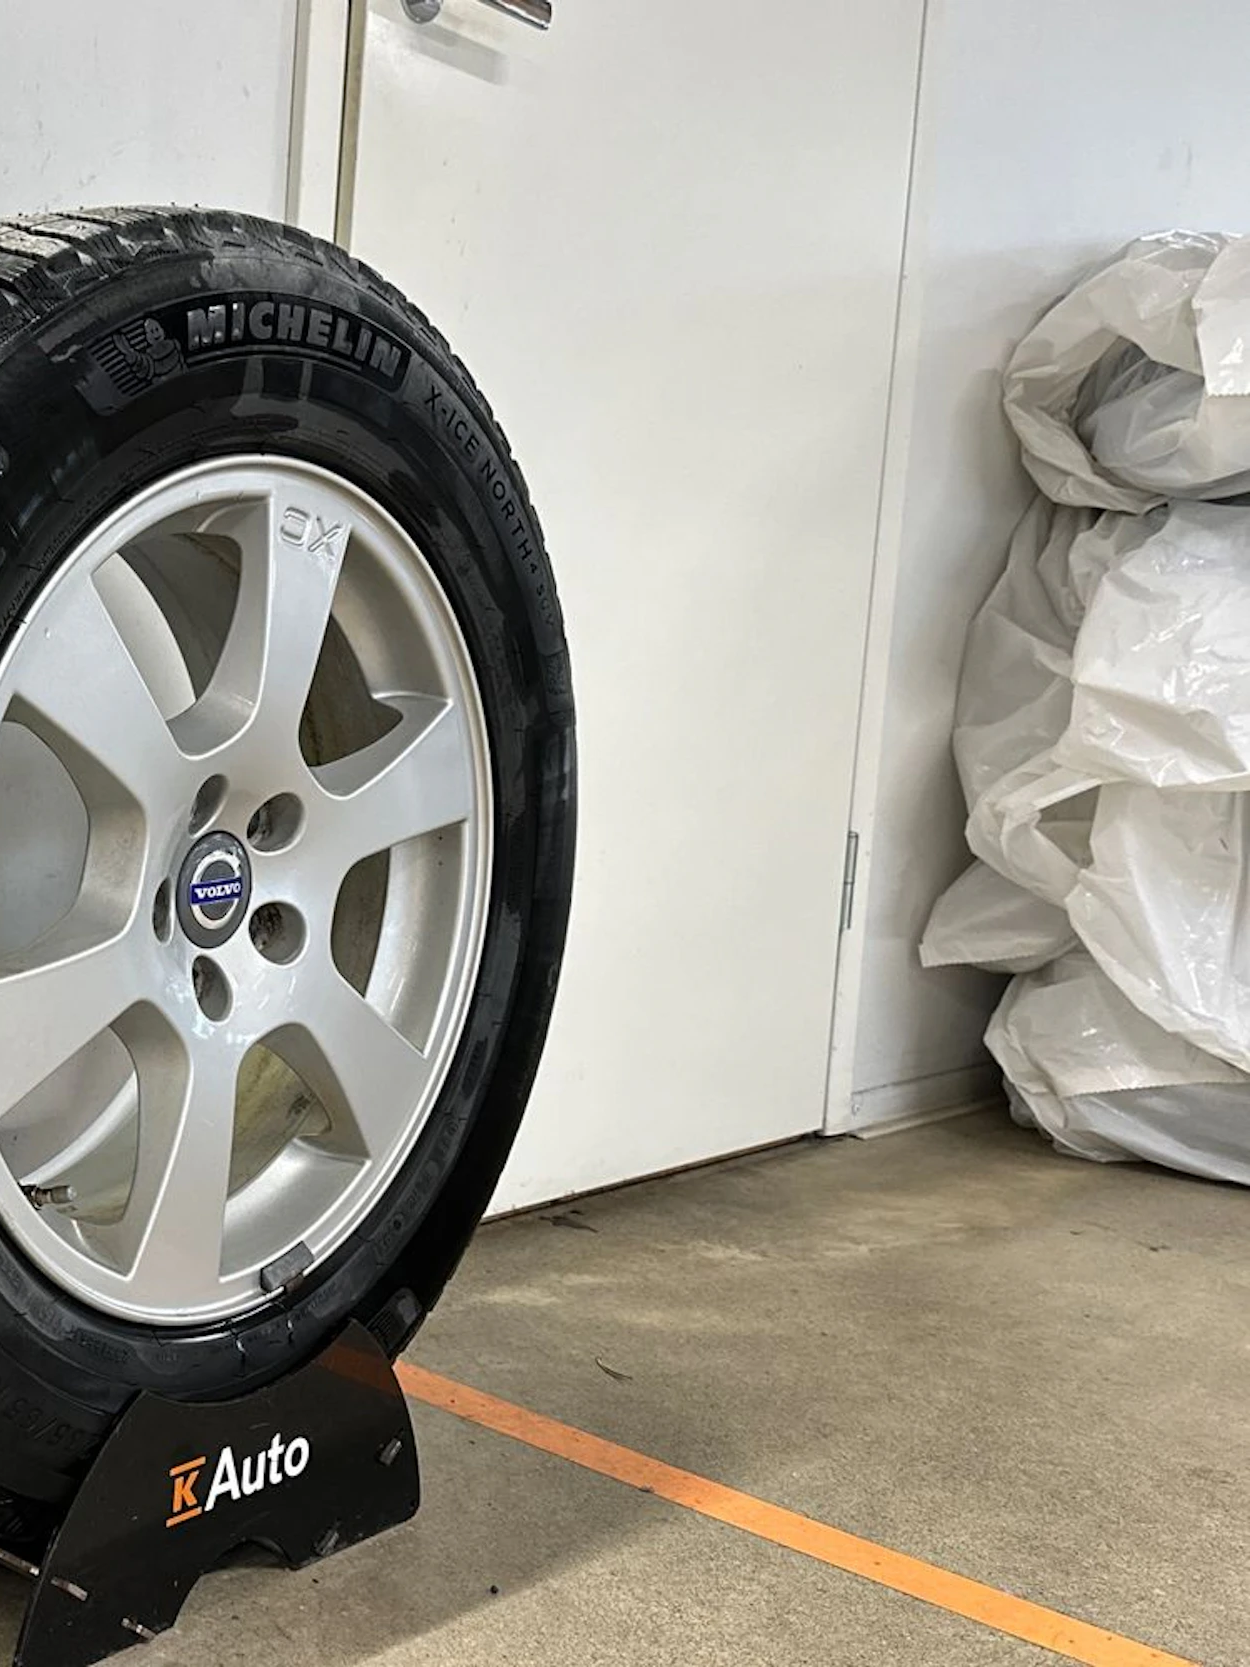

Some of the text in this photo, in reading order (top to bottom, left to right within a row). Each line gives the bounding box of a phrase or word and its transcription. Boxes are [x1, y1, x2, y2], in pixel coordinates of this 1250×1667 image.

[187, 301, 401, 377] MICHELIN
[424, 385, 480, 457] X-ICE
[194, 882, 241, 899] VOLVO
[204, 1432, 310, 1512] Auto
